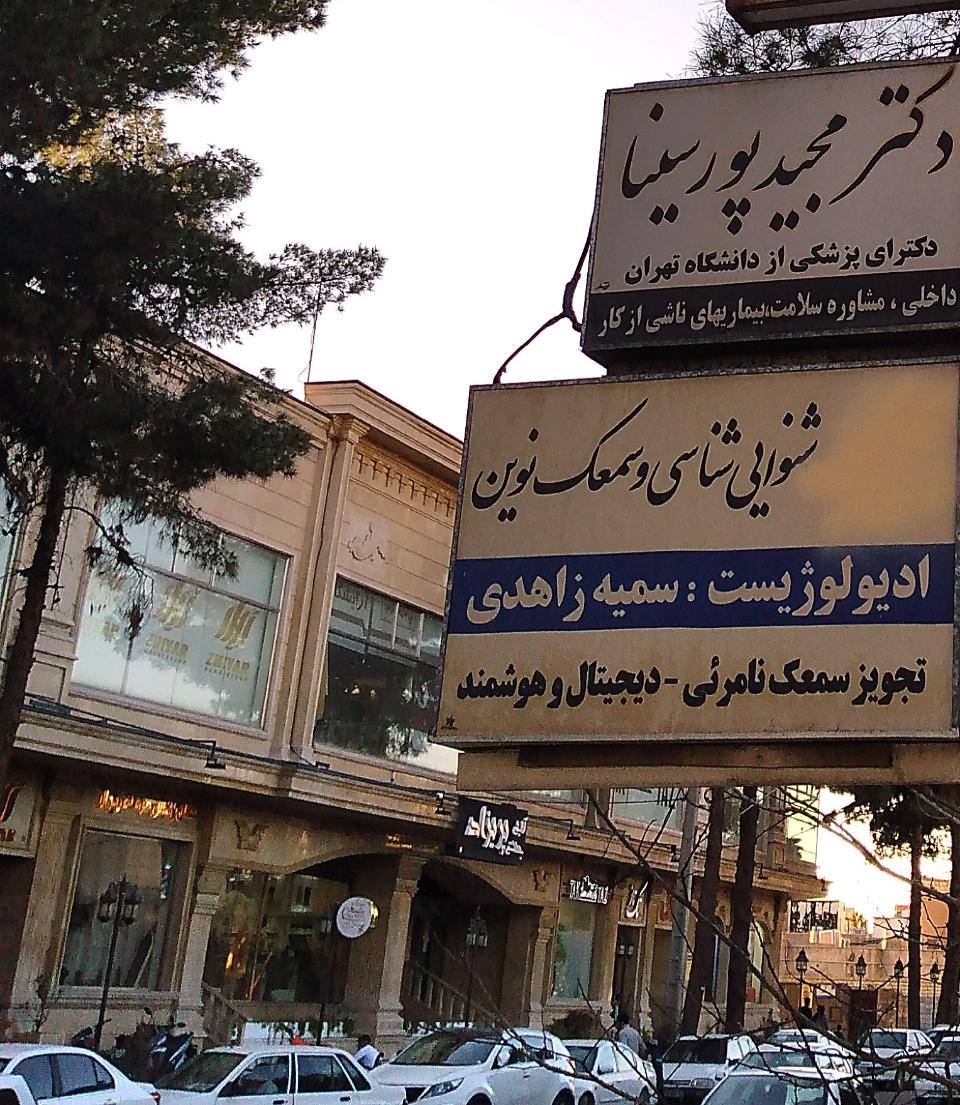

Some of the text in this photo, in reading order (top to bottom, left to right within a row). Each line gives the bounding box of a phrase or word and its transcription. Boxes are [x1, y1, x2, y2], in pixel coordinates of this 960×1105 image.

[829, 65, 955, 206] دکتر
[752, 113, 848, 232] مجید
[624, 254, 680, 285] تهران
[764, 246, 786, 275] از
[789, 243, 861, 273] پزشکی
[865, 236, 939, 269] دکترای
[598, 305, 626, 337] کار
[625, 304, 643, 335] از
[645, 301, 686, 333] ناشی
[827, 288, 885, 322] مشاوره
[902, 283, 957, 317] داخلی
[532, 396, 649, 496] سمعک
[471, 427, 539, 522] نوین
[466, 565, 585, 625] زاهدی
[592, 573, 681, 619] سمیه
[707, 554, 931, 618] ادیولوژیست
[456, 663, 547, 710] هوشمند
[547, 680, 563, 710] و
[566, 660, 661, 710] دیجیتال
[681, 656, 767, 710] نامرئی
[768, 659, 850, 699] سمعک
[851, 657, 928, 710] تجویز
